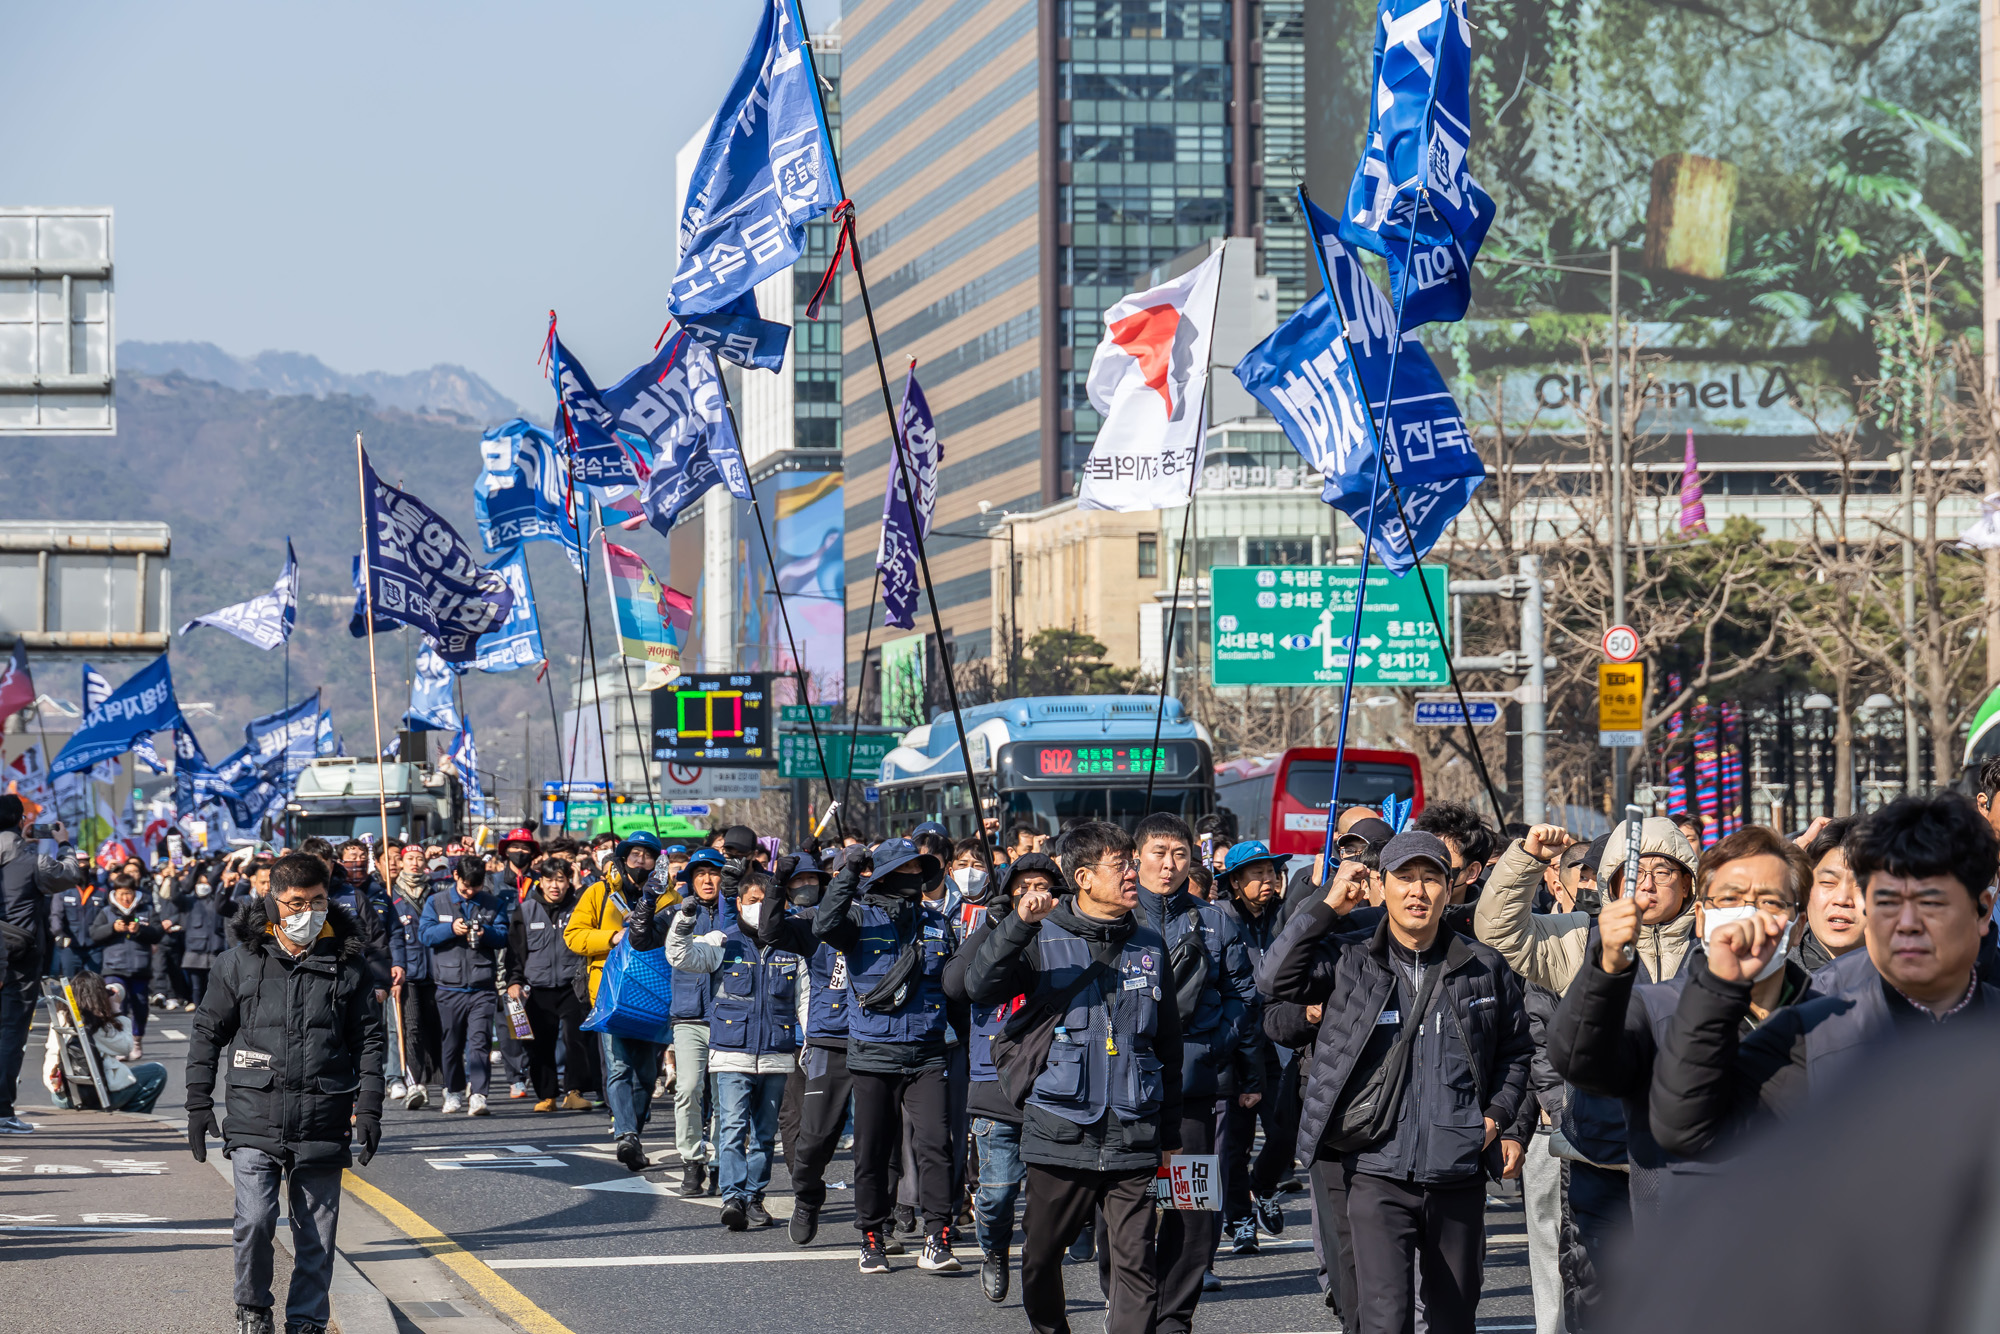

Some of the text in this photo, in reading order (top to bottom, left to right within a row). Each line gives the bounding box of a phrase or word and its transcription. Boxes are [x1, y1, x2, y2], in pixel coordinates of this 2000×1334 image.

[1280, 570, 1323, 587] 독립문
[1280, 591, 1323, 608] 광화문
[1217, 632, 1274, 649] 서대문역
[1610, 636, 1632, 651] 50
[1040, 749, 1073, 774] 602
